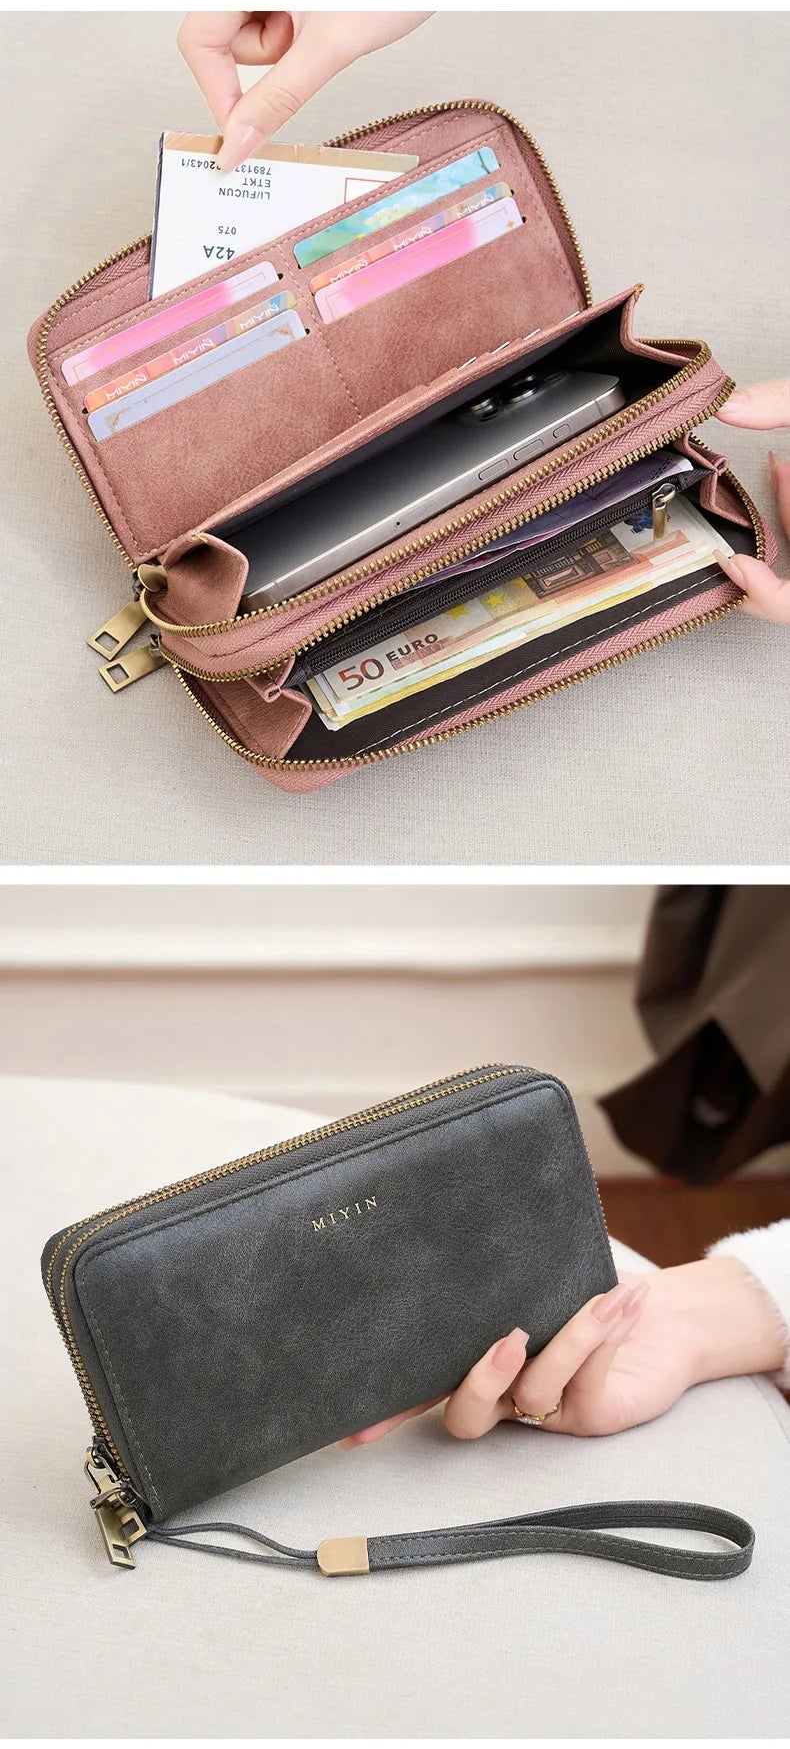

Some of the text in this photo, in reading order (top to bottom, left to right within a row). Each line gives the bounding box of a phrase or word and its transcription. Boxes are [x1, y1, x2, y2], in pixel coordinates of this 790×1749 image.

[242, 177, 271, 188] ETKT
[219, 188, 271, 200] LI/FUCUN
[218, 225, 237, 235] 075
[203, 244, 235, 260] 42A
[106, 302, 280, 400] MIYIN MIYIN MIYIN
[338, 634, 438, 691] 50 EURO
[312, 1196, 377, 1231] MIYIN
